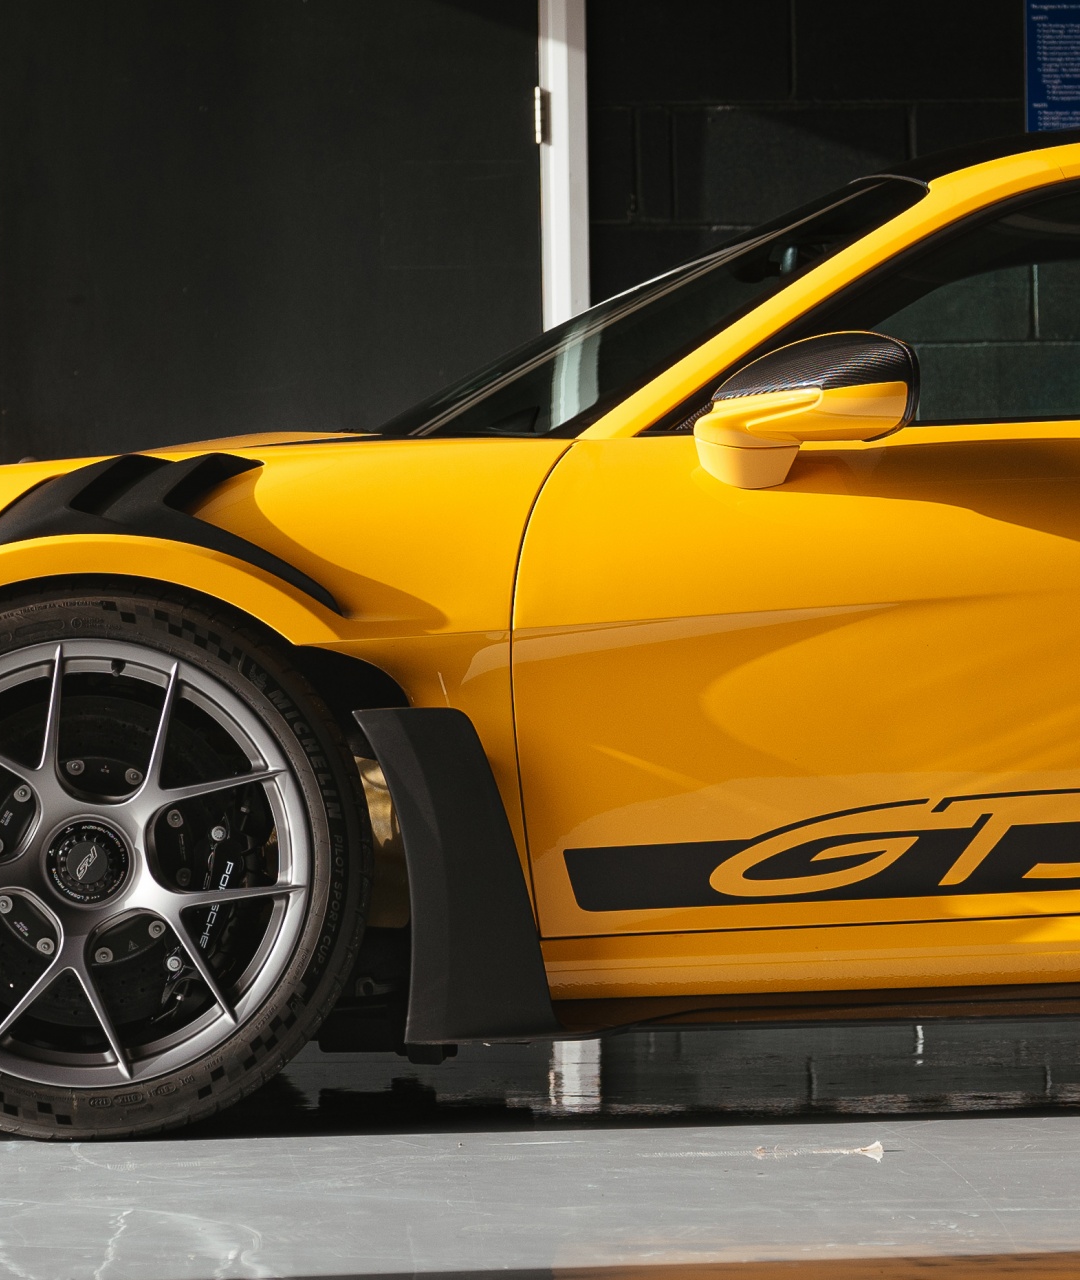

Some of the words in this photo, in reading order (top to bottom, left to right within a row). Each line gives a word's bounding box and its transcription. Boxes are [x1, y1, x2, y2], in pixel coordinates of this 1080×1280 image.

[268, 689, 342, 820] MICHELIN
[334, 834, 343, 875] PILOT
[709, 789, 1080, 897] GT
[329, 883, 343, 931] SPORT
[318, 935, 331, 963] CUP
